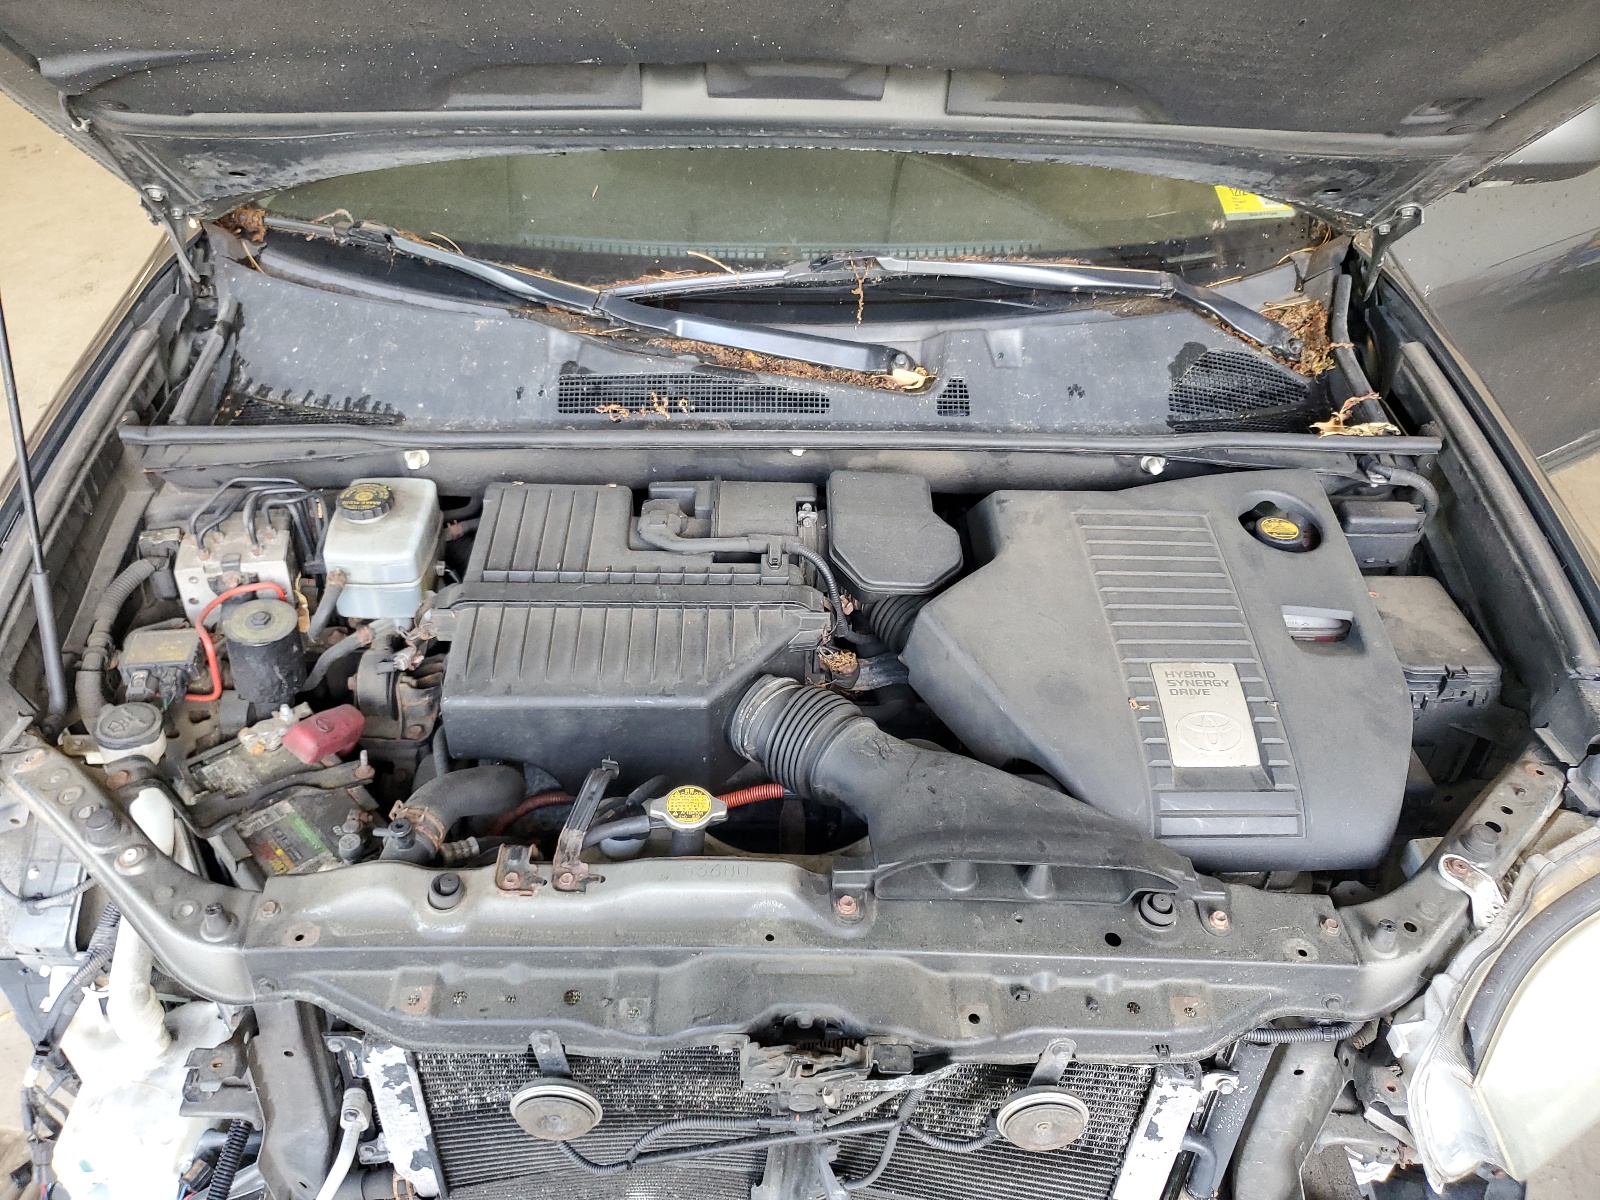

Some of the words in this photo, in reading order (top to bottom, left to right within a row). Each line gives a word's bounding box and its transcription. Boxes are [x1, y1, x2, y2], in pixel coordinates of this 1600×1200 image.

[1164, 670, 1216, 679] HYBRID
[1166, 679, 1230, 688] SYNERGY
[1169, 688, 1211, 696] DRIVE
